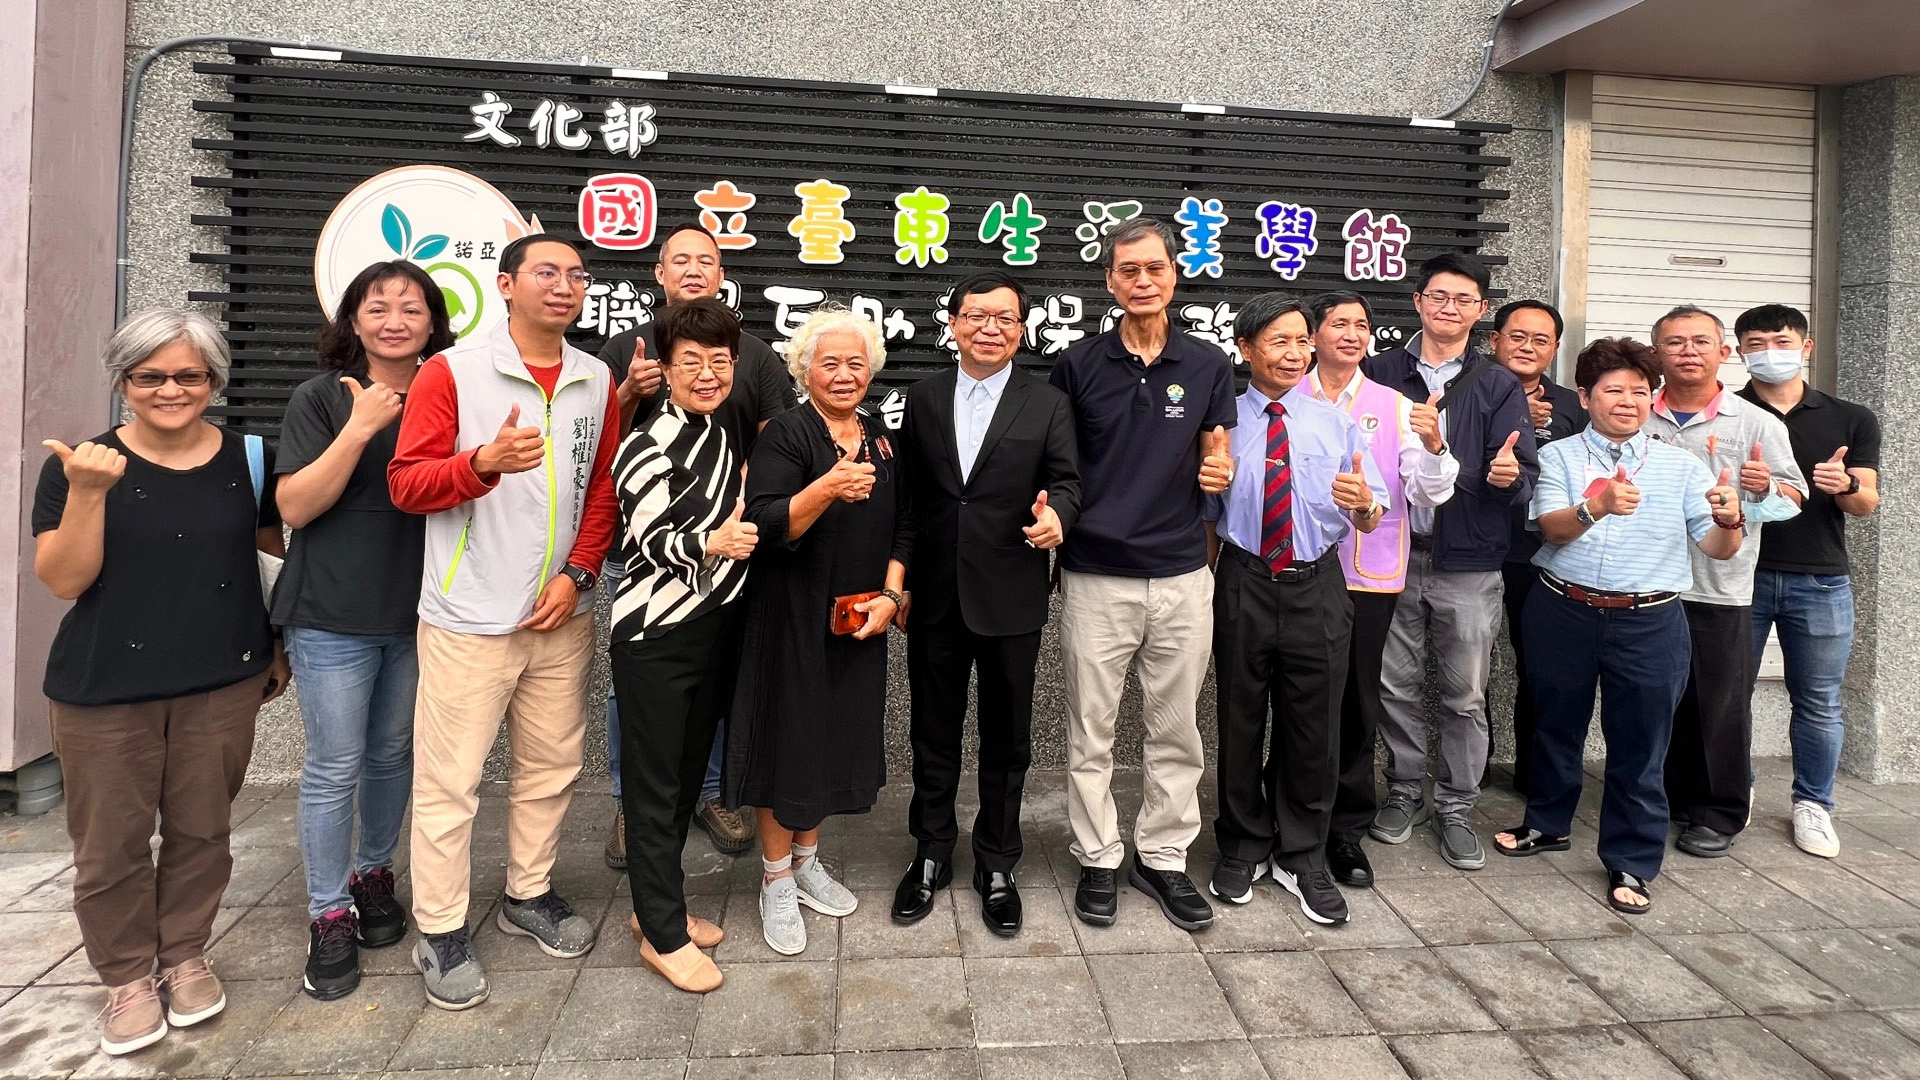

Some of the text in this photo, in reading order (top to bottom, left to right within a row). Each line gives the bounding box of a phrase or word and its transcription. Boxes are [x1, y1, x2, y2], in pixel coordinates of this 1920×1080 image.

[463, 90, 658, 158] 文化部
[454, 240, 497, 260] 諾亞
